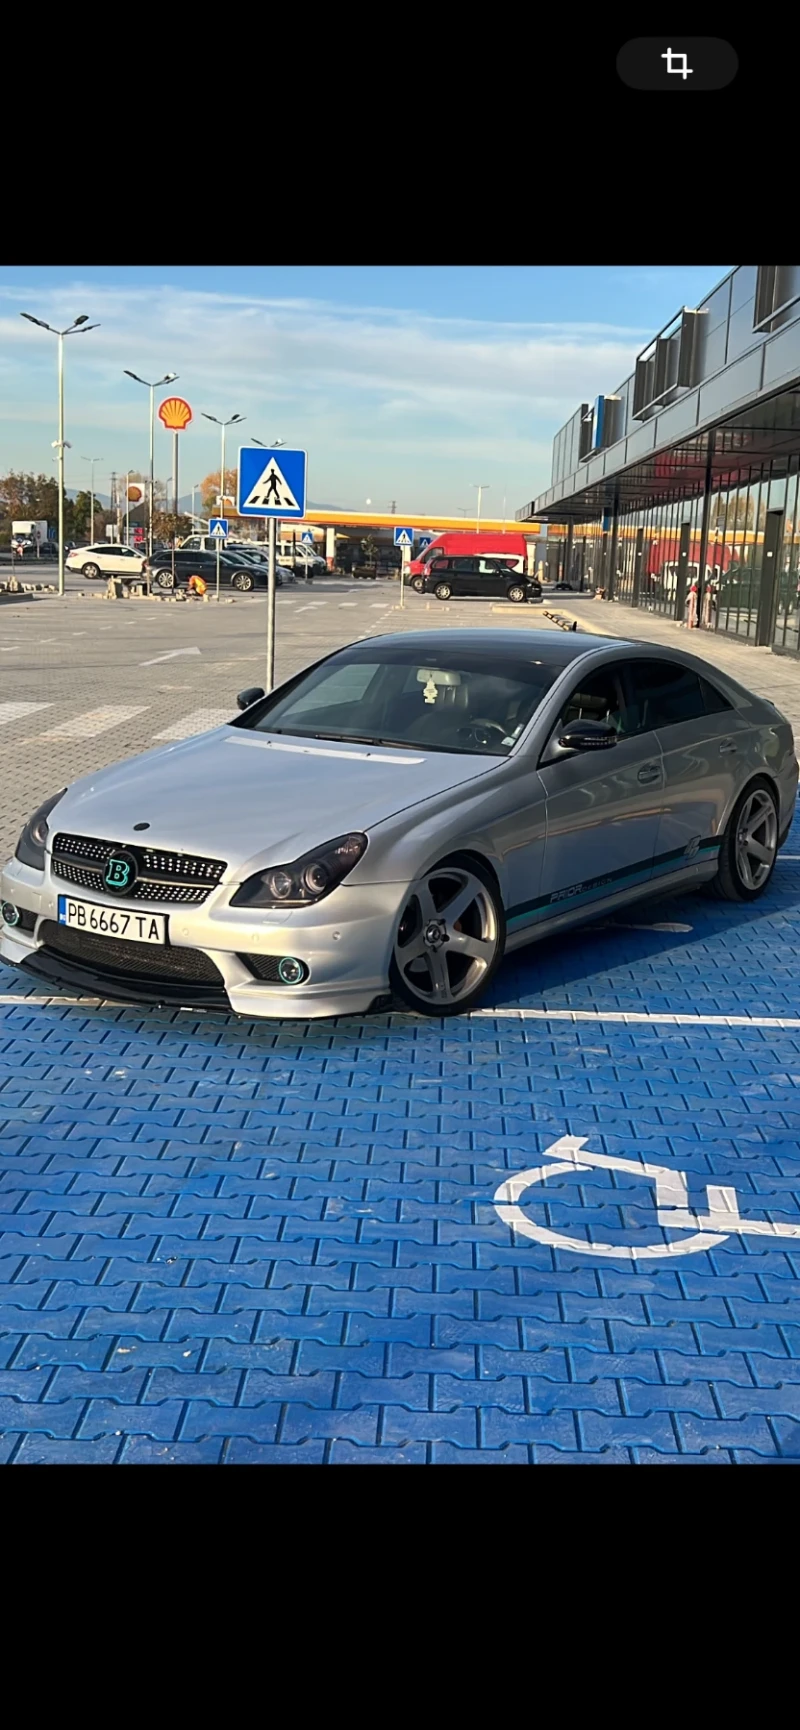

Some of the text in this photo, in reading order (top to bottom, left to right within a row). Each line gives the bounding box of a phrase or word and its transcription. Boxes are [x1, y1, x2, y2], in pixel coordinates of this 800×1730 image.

[106, 859, 129, 886] B
[68, 903, 159, 940] PB 6667 TA
